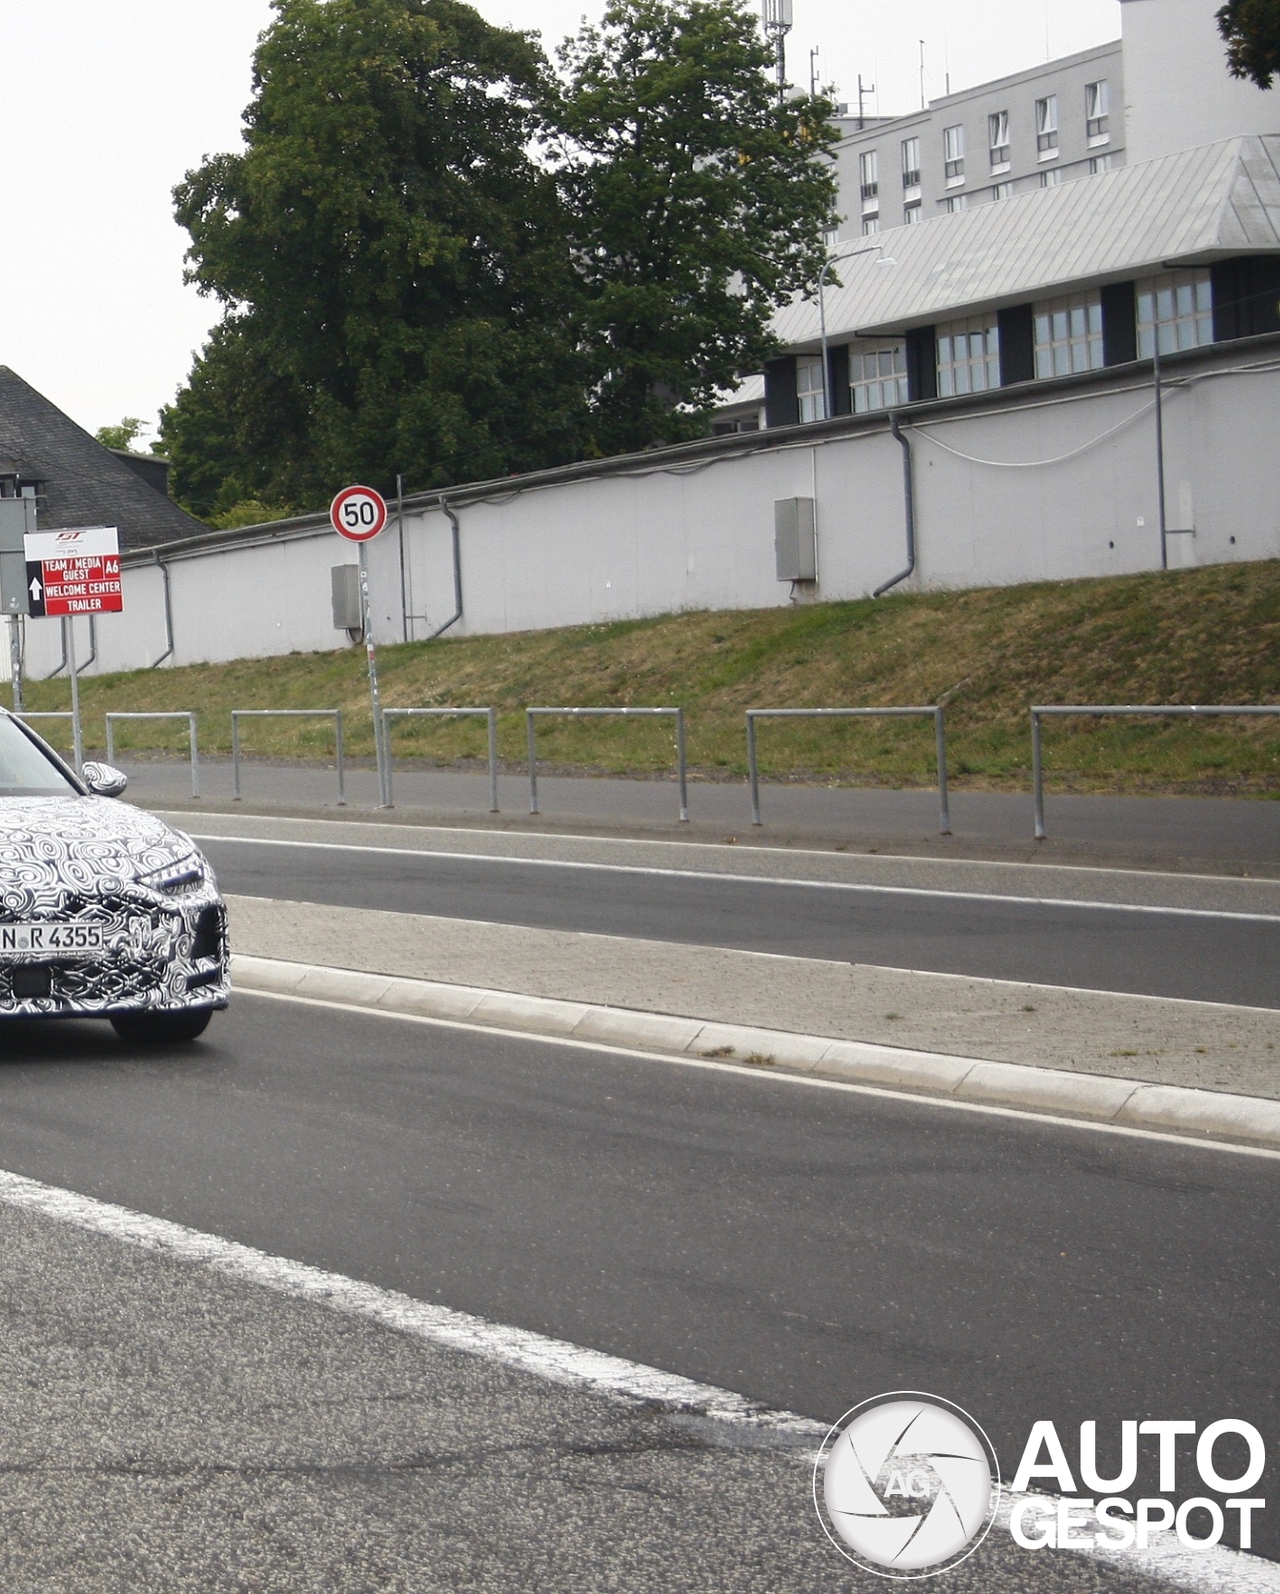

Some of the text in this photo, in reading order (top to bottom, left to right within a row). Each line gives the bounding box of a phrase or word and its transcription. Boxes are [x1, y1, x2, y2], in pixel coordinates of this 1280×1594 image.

[343, 501, 375, 527] 50
[44, 557, 101, 571] TEAM / MEDIA
[106, 560, 119, 574] A6
[63, 569, 90, 581] GUEST
[46, 581, 121, 597] WELCOME CENTER
[67, 598, 102, 612] TRAILER
[31, 928, 43, 948] R
[49, 926, 100, 947] 4355
